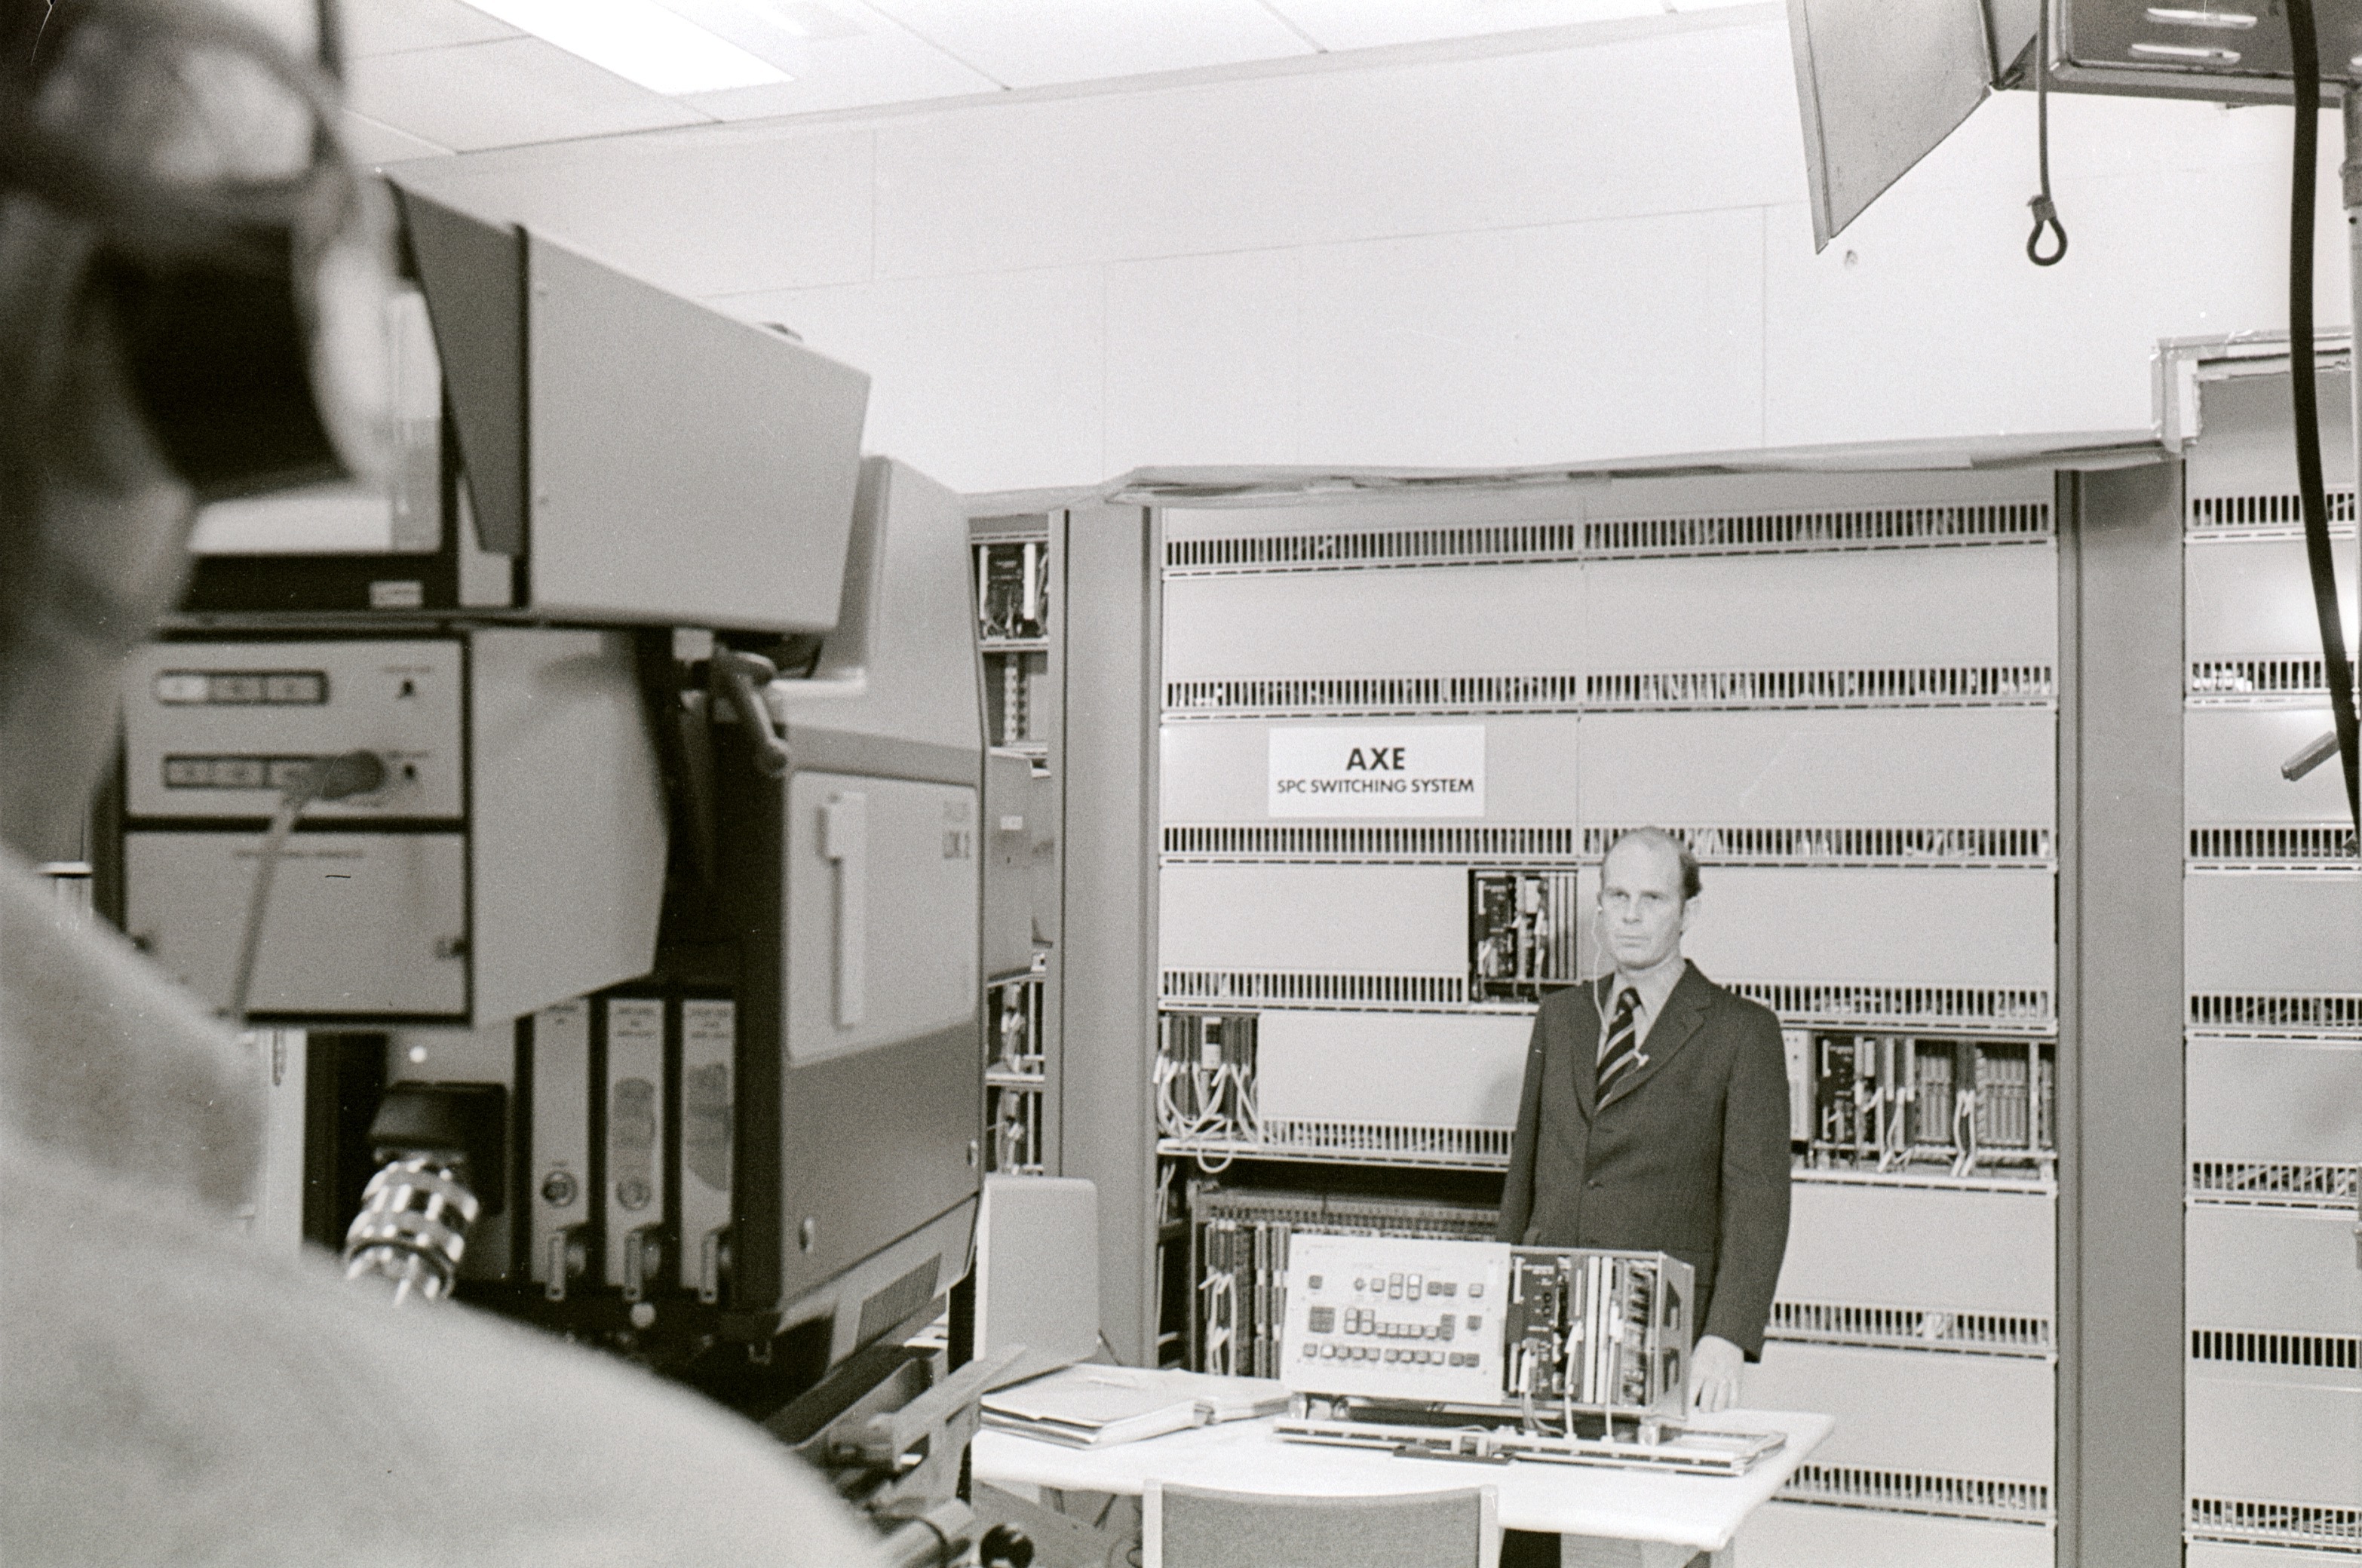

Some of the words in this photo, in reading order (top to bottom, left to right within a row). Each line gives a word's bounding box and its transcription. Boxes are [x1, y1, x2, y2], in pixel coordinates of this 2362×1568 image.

[1346, 747, 1406, 771] AXE
[1278, 780, 1306, 793] SPC
[1311, 779, 1406, 793] SWITCHING
[1411, 778, 1474, 793] SYSTEM
